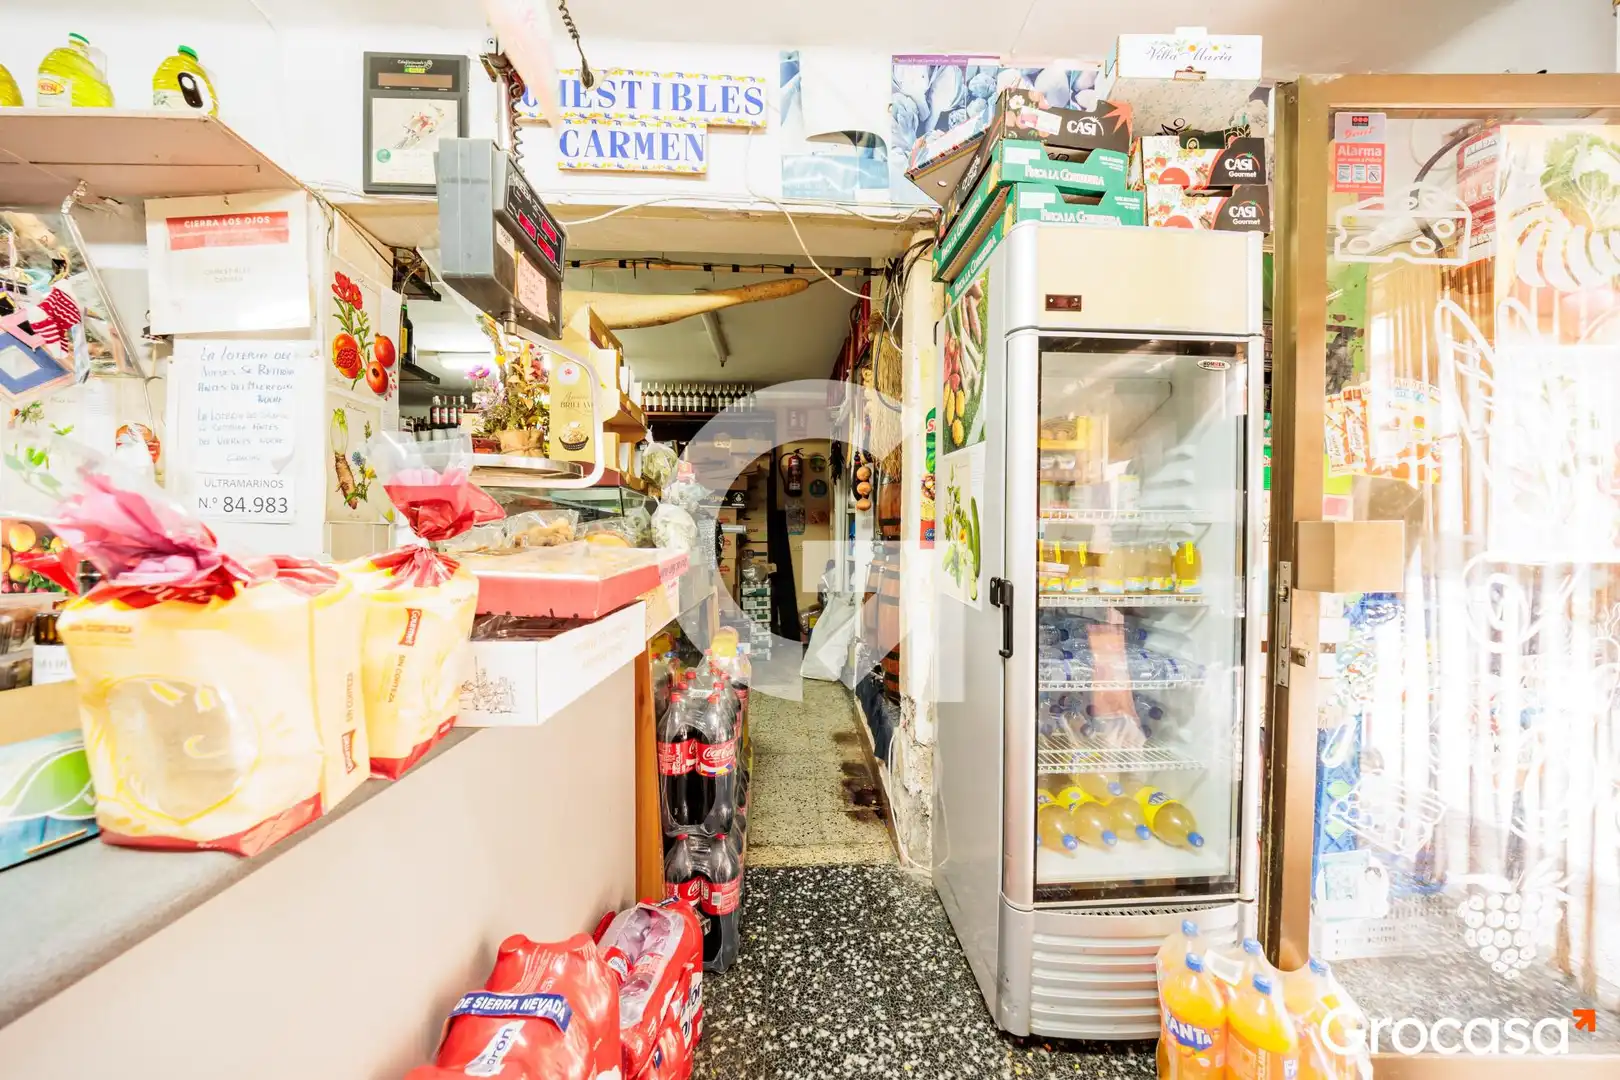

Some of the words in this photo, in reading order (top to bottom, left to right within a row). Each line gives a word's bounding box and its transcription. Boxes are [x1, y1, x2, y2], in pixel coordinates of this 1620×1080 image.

[1066, 119, 1097, 136] CASI
[559, 129, 706, 162] CARMEN
[1337, 144, 1382, 157] Alarma
[1224, 158, 1253, 171] CASI
[1228, 206, 1256, 218] CASI
[184, 219, 219, 229] CIERRA
[223, 218, 241, 226] LOS
[245, 216, 271, 225] OJOS
[1232, 218, 1261, 226] Gourmet
[204, 478, 284, 489] ULTRAMARINOS
[223, 496, 288, 514] 84.983
[453, 997, 469, 1012] DE
[475, 996, 519, 1012] SIERRA
[519, 997, 567, 1023] NEVADA
[1164, 1008, 1213, 1046] FANTA
